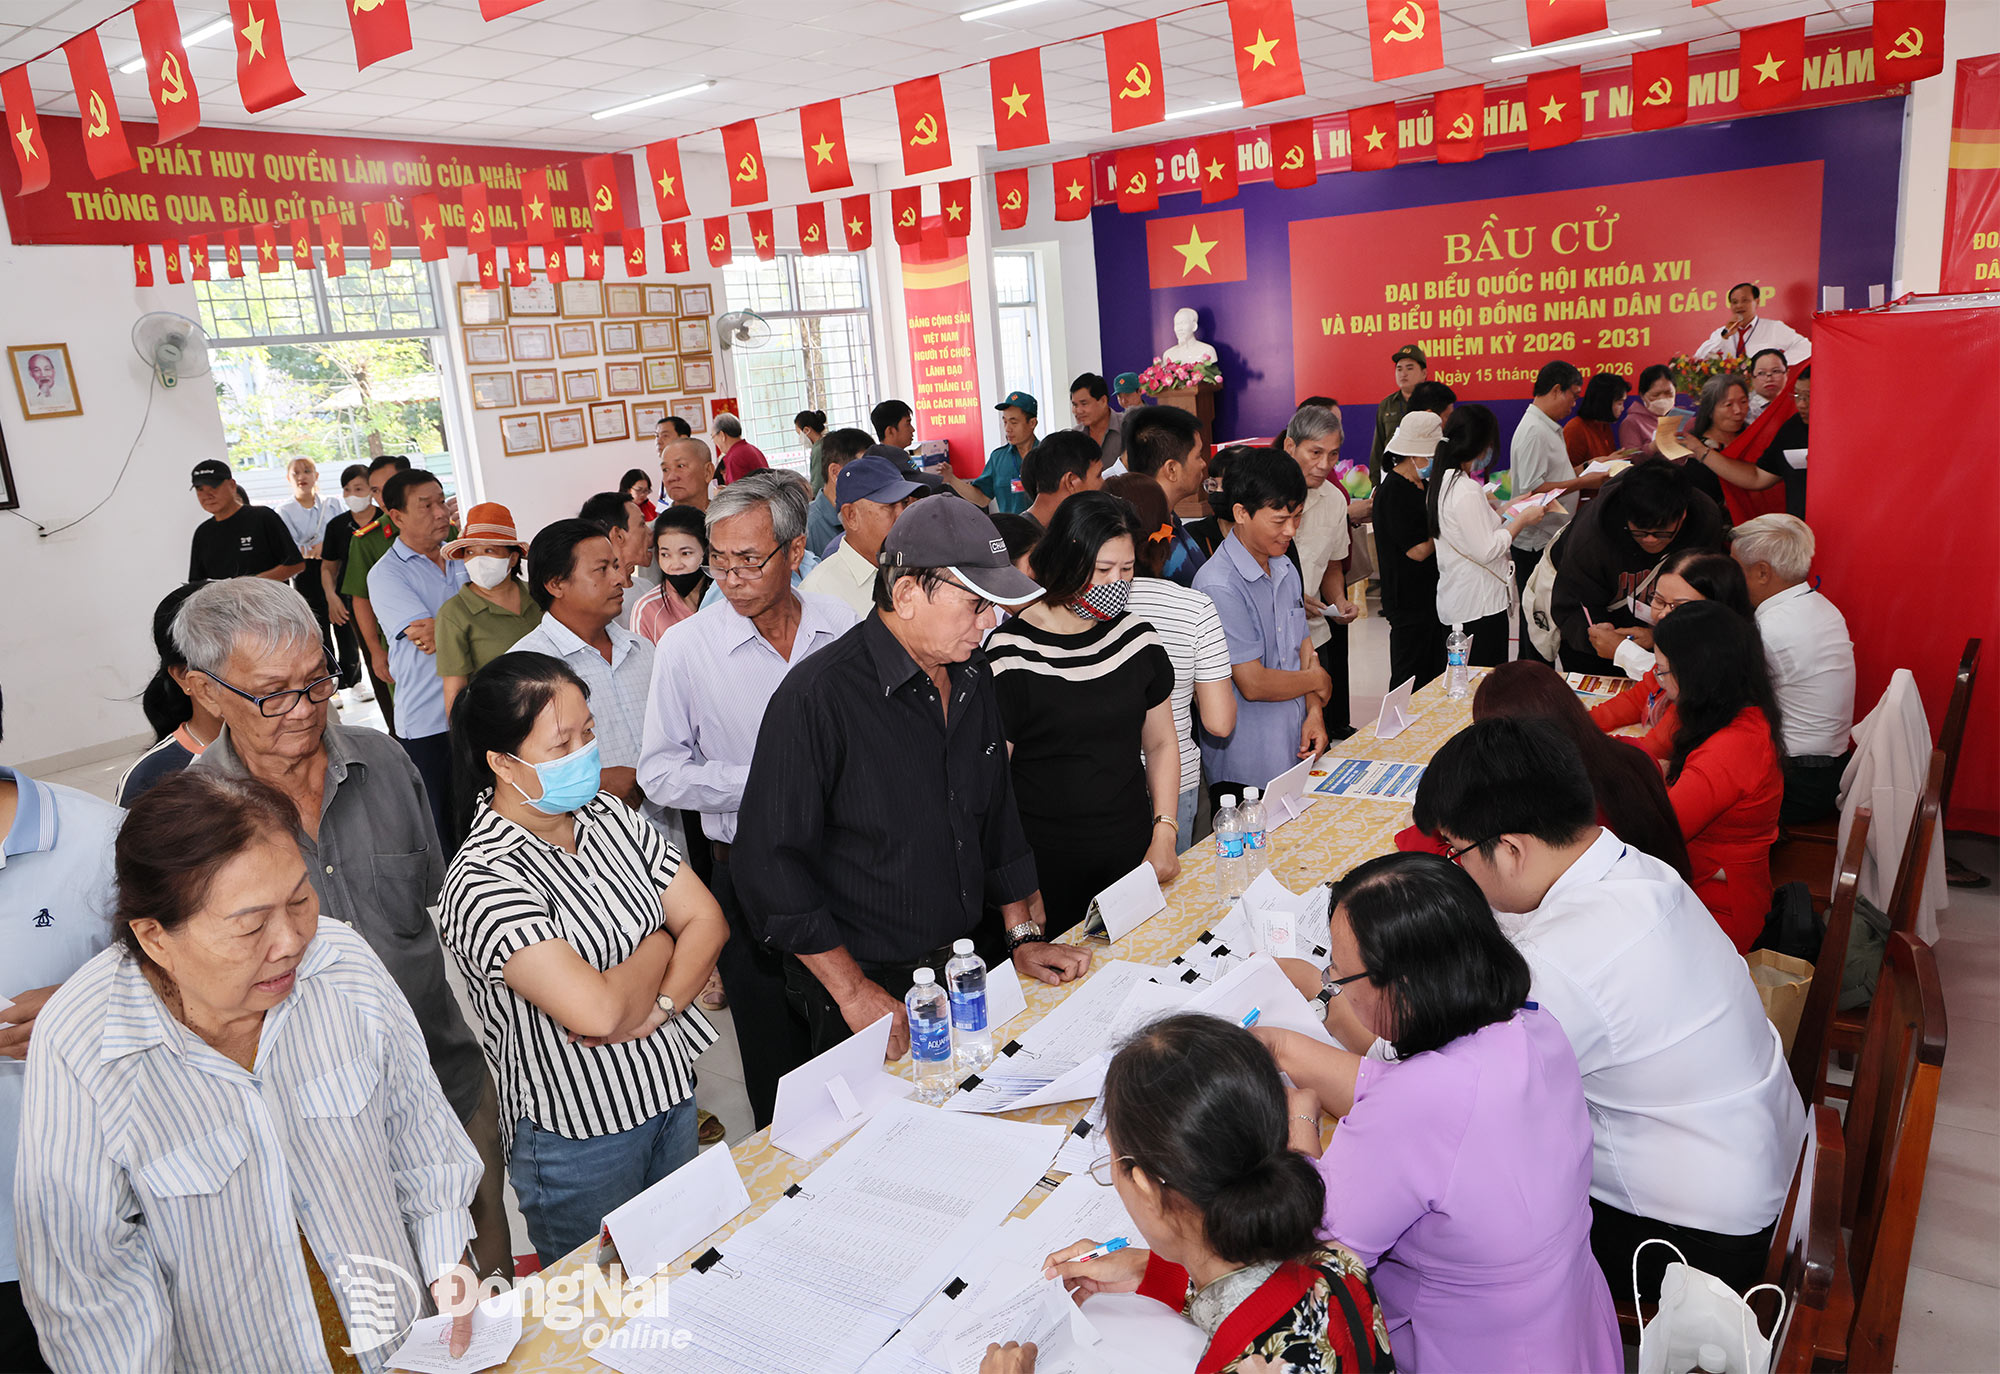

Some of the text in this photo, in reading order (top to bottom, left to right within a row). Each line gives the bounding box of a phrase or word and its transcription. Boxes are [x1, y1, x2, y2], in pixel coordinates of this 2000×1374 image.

[1238, 137, 1272, 172] HÒ
[1398, 109, 1434, 149] HỦ
[1802, 46, 1876, 91] NĂM
[137, 143, 202, 176] PHÁT
[209, 150, 255, 178] HUY
[263, 149, 338, 183] QUYỀN
[342, 154, 388, 185] LÀM
[392, 155, 432, 186] CHỦ
[437, 157, 474, 187] CỦA
[532, 164, 568, 191] ÂN
[66, 187, 159, 221] THÔNG
[165, 195, 216, 224] QUA
[219, 188, 269, 223] BẦU
[274, 191, 305, 224] CỬ
[311, 195, 357, 225] DÂN
[1443, 205, 1620, 265] BẦU CỬ
[1973, 232, 2000, 250] ĐO
[1385, 259, 1691, 305] ĐẠI BIỂU QUỐC HỘI KHÓA XVI
[909, 311, 971, 328] ĐẢNG CỘNG SẢN
[1321, 314, 1345, 335] VÀ
[1350, 315, 1382, 336] ĐẠI
[1388, 304, 1432, 331] BIỂU
[1439, 305, 1472, 331] HỘI
[1478, 299, 1537, 325] ĐỒNG
[1544, 296, 1605, 321] NHÂN
[1613, 292, 1661, 317] DÂN
[1669, 288, 1717, 313] CÁC
[923, 331, 959, 345] VIỆT NAM
[1418, 334, 1484, 360] NHIỆM
[1490, 331, 1517, 354] KỲ
[1523, 332, 1576, 353] 2026
[1598, 327, 1650, 349] 2031
[914, 349, 938, 361] NGƯỜI
[950, 347, 971, 358] CHỨC
[925, 364, 962, 377] LÃNH ĐẠO
[1434, 370, 1471, 386] Ngày
[1476, 369, 1492, 381] 15
[1497, 368, 1539, 385] tháng
[1596, 362, 1633, 377] 2026
[918, 379, 973, 395] MỌI THẮNG LỢI
[916, 397, 978, 410] CỦA CÁCH MẠNG
[930, 414, 966, 427] VIỆT NAM
